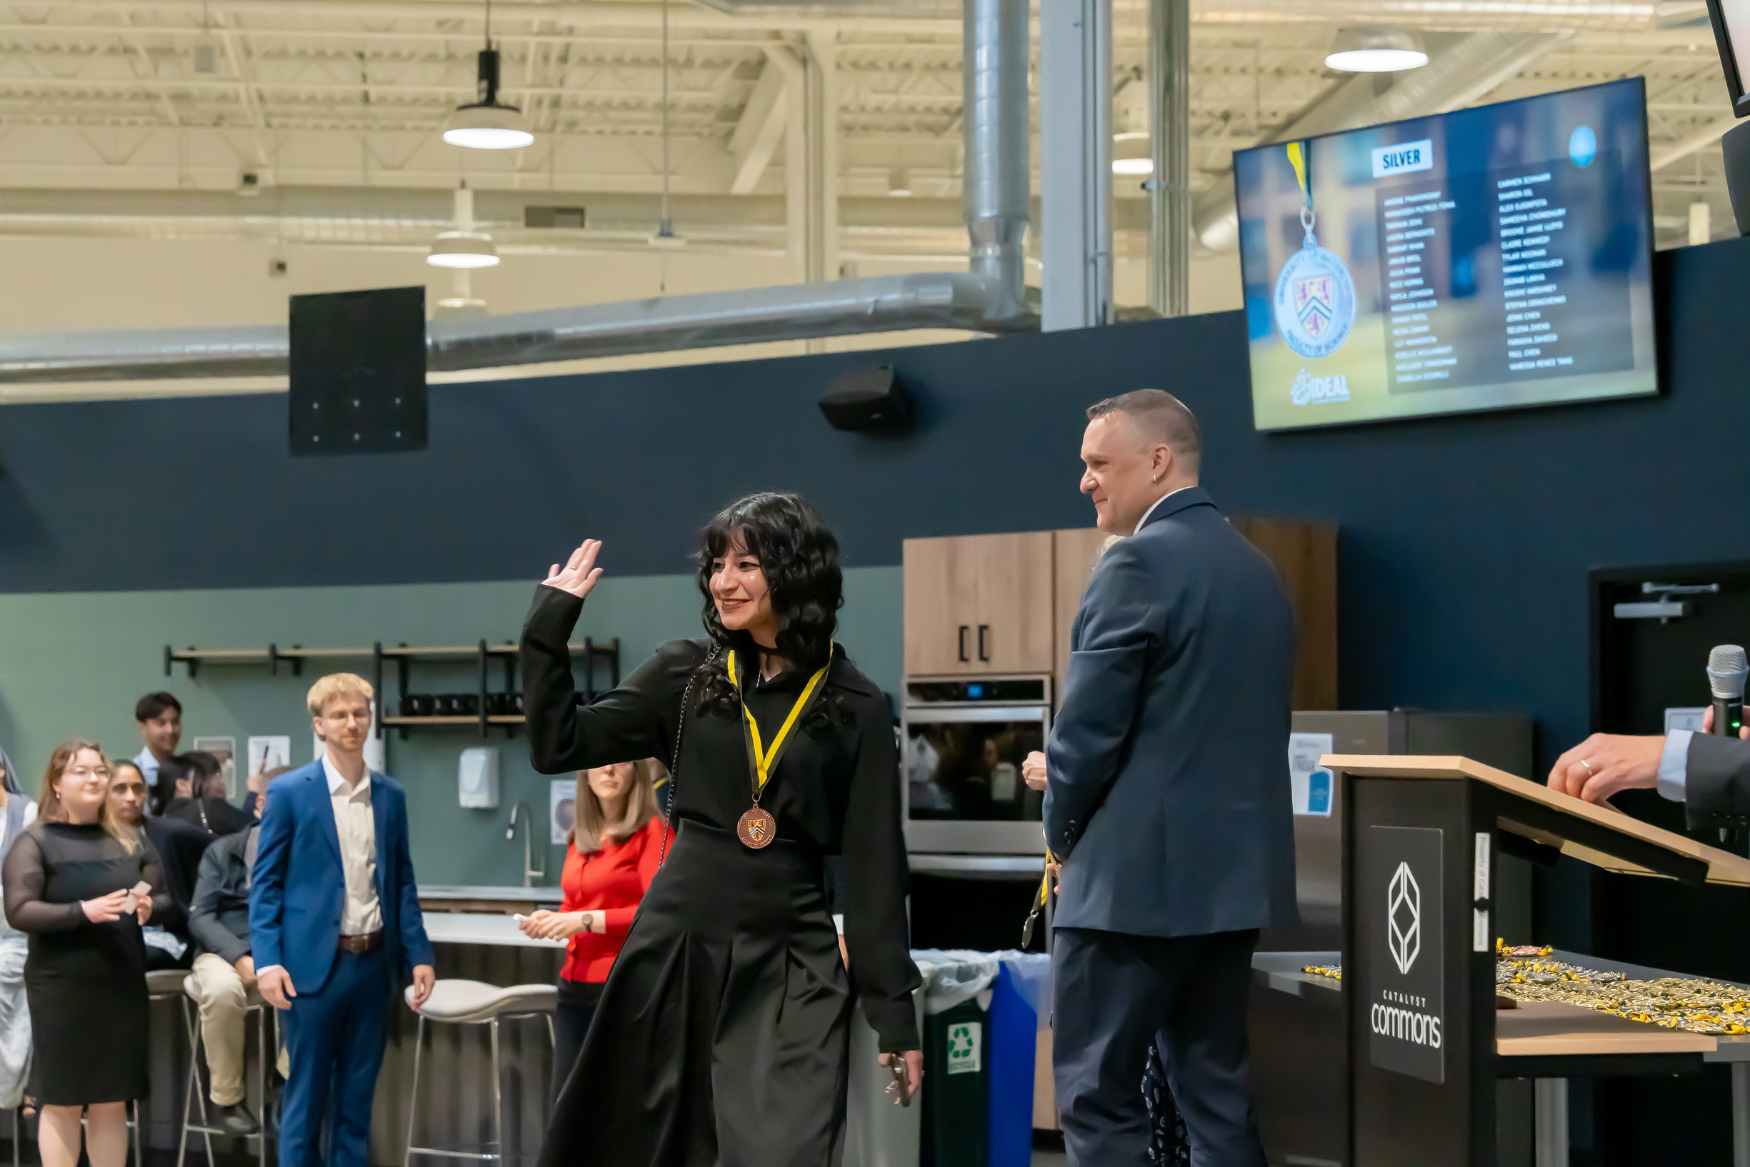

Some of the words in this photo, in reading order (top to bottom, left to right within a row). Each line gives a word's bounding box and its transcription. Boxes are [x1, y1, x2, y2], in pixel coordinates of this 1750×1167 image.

[1382, 148, 1421, 170] SILVER
[1310, 374, 1350, 398] IDEAL
[1382, 989, 1427, 1008] CATALYST
[1371, 1002, 1442, 1049] commons
